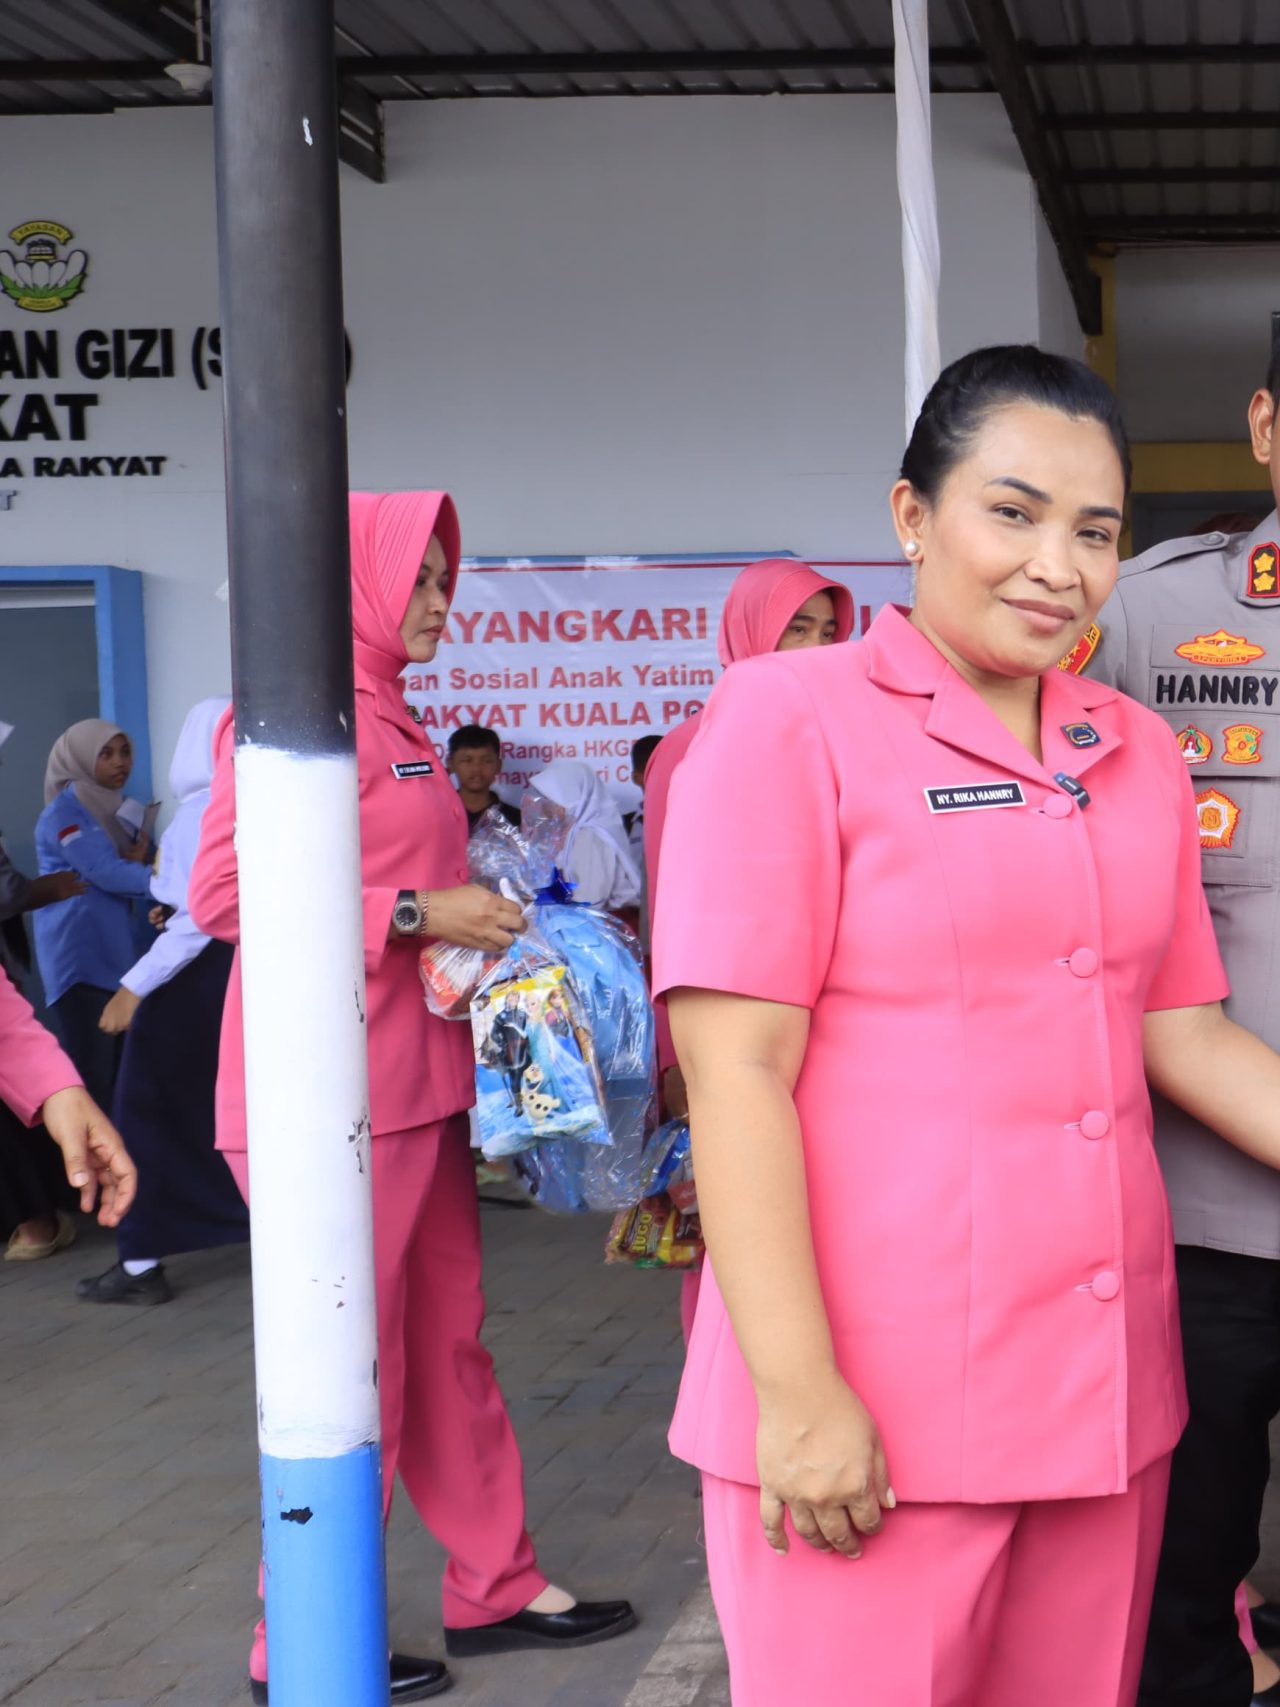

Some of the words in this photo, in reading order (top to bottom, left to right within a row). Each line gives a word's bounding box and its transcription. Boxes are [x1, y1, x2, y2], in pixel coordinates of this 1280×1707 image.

[76, 329, 175, 380] GIZI
[34, 456, 167, 477] RAKYAT
[450, 667, 538, 690] Sosial
[549, 665, 623, 688] Anak
[633, 664, 714, 686] Yatim
[1155, 674, 1279, 706] HANNRY
[539, 701, 652, 727] KUALA
[501, 741, 577, 761] Rangka
[936, 794, 953, 805] NY.
[953, 792, 977, 804] RIKA
[976, 788, 1014, 801] HANNRY
